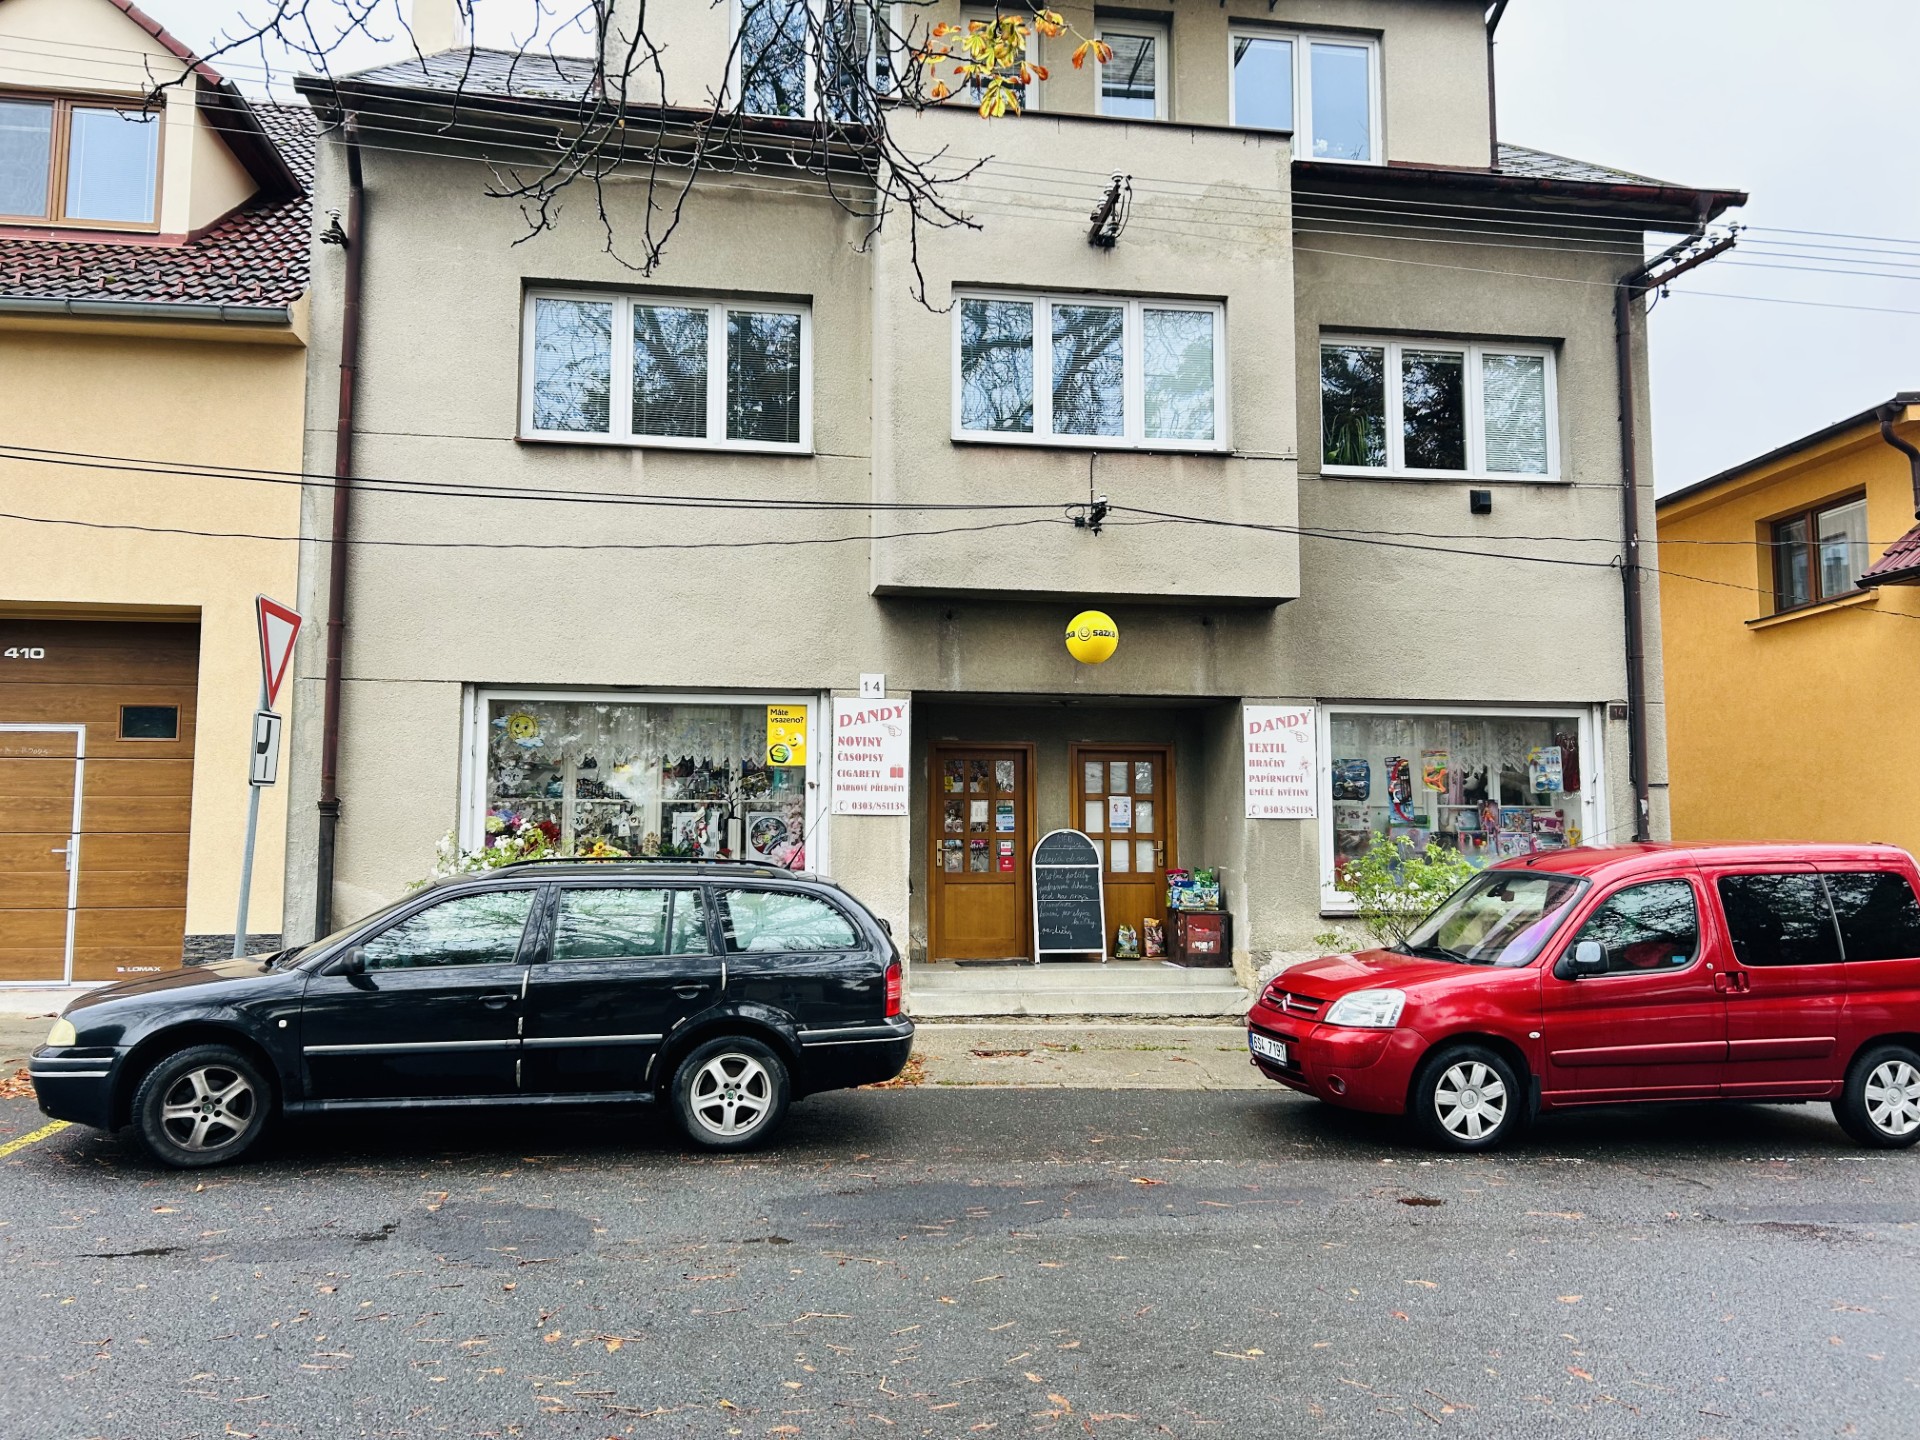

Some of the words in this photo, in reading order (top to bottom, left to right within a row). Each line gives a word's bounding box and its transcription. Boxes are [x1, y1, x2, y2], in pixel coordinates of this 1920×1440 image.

[4, 647, 45, 659] 410
[864, 681, 880, 692] 14
[770, 716, 804, 724] vsazeno?
[839, 705, 905, 728] DANDY
[1249, 711, 1311, 735] DANDY
[837, 736, 883, 748] NOVINY
[1248, 742, 1287, 753] TEXTIL
[837, 750, 884, 763] ČASOPISY
[1248, 758, 1286, 768] HRAČKY
[836, 769, 881, 779] CIGARETY
[1248, 772, 1304, 784] PAPÍRNICTVÍ
[836, 783, 868, 792] DÁRKOVÉ
[870, 782, 905, 793] PŘEDMĚTY
[1249, 787, 1274, 797] UMĚLÉ
[1277, 788, 1309, 797] KVĚTINY
[851, 801, 906, 811] 0303/851138
[1268, 1041, 1284, 1058] 7197
